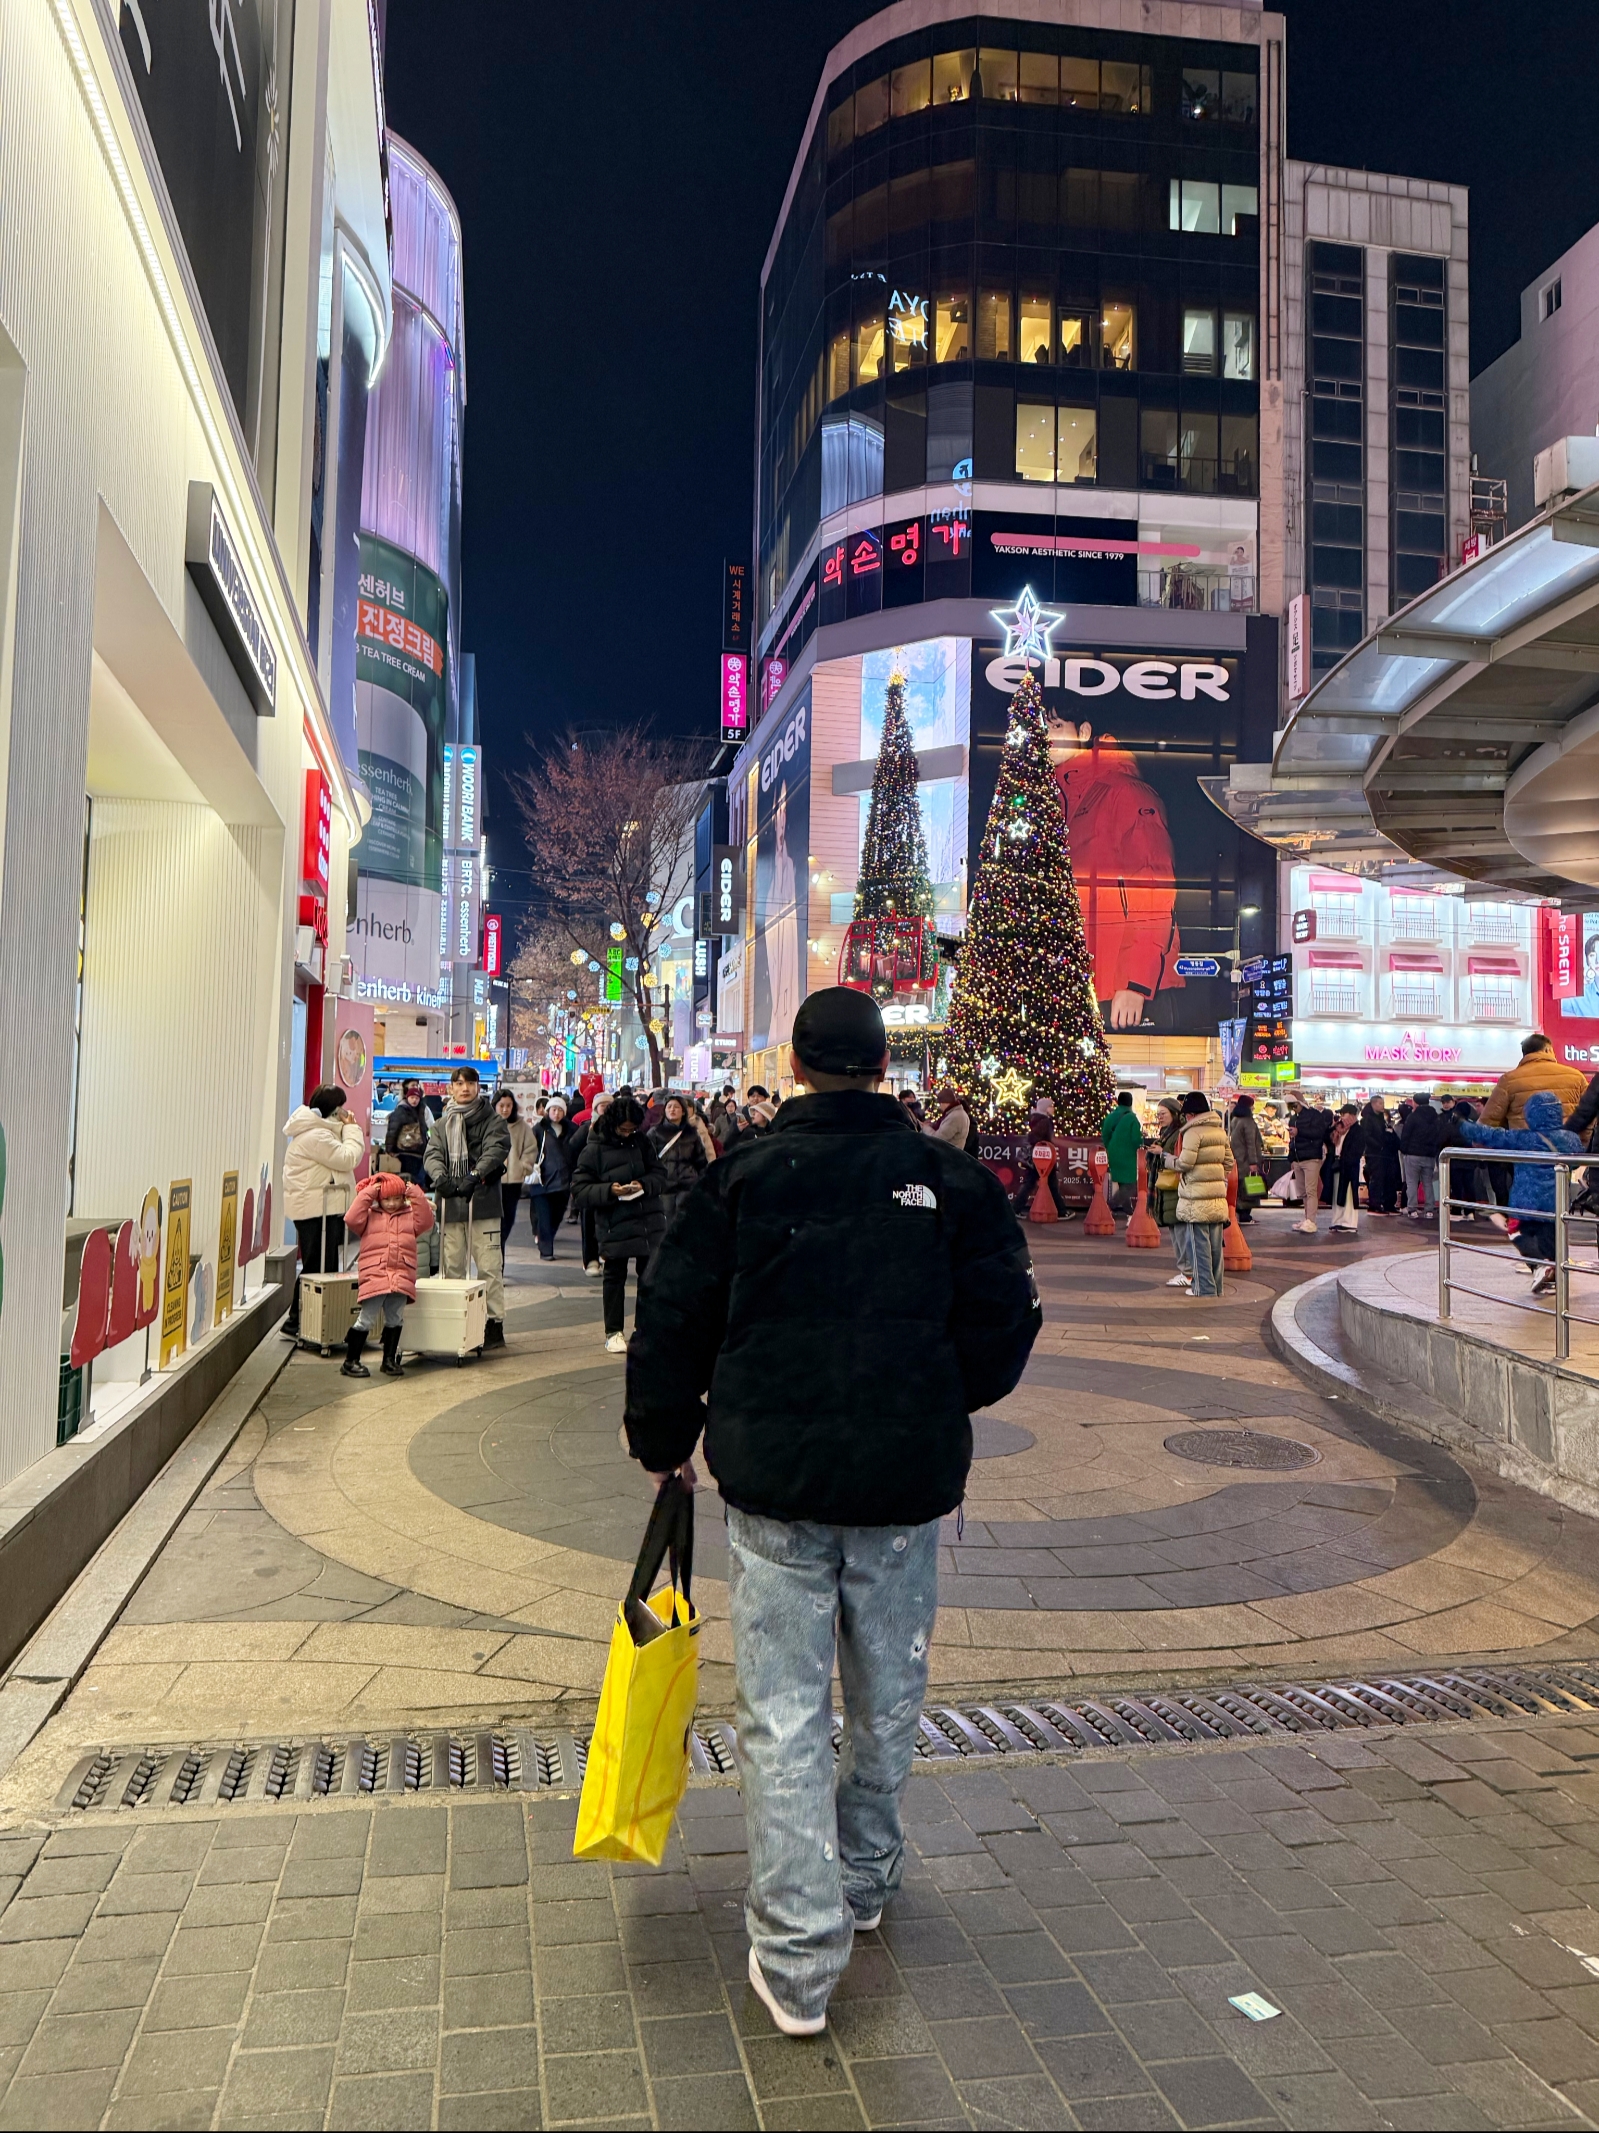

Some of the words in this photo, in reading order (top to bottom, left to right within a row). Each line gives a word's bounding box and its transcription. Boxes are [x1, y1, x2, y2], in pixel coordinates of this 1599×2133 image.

[823, 522, 967, 585] 약손명가
[994, 545, 1029, 555] YAKSON
[1032, 548, 1076, 558] AESTHETIC
[1078, 550, 1102, 559] SINCE
[1104, 552, 1124, 560] 1979
[729, 565, 744, 576] WE
[731, 580, 740, 632] 시계거래소
[362, 644, 380, 661] TEA
[381, 652, 402, 670] TREE
[402, 662, 426, 683] CREAM
[985, 656, 1230, 702] EIDER
[728, 673, 741, 726] 약손명가
[727, 729, 741, 740] 5F
[761, 706, 807, 793] EIDER
[720, 858, 732, 922] EIDER
[460, 900, 472, 956] essenherb
[695, 940, 706, 976] LUSH
[1558, 935, 1570, 986] SAEM
[474, 978, 484, 1006] MLB
[1401, 1030, 1429, 1046] ALL
[1365, 1045, 1410, 1061] MASK
[1414, 1047, 1461, 1062] STORY
[1565, 1044, 1588, 1061] the
[978, 1146, 1012, 1161] 2024
[172, 1191, 188, 1206] CAUTION
[892, 1191, 923, 1199] NORTH
[906, 1184, 923, 1192] THE
[900, 1198, 923, 1206] FACE
